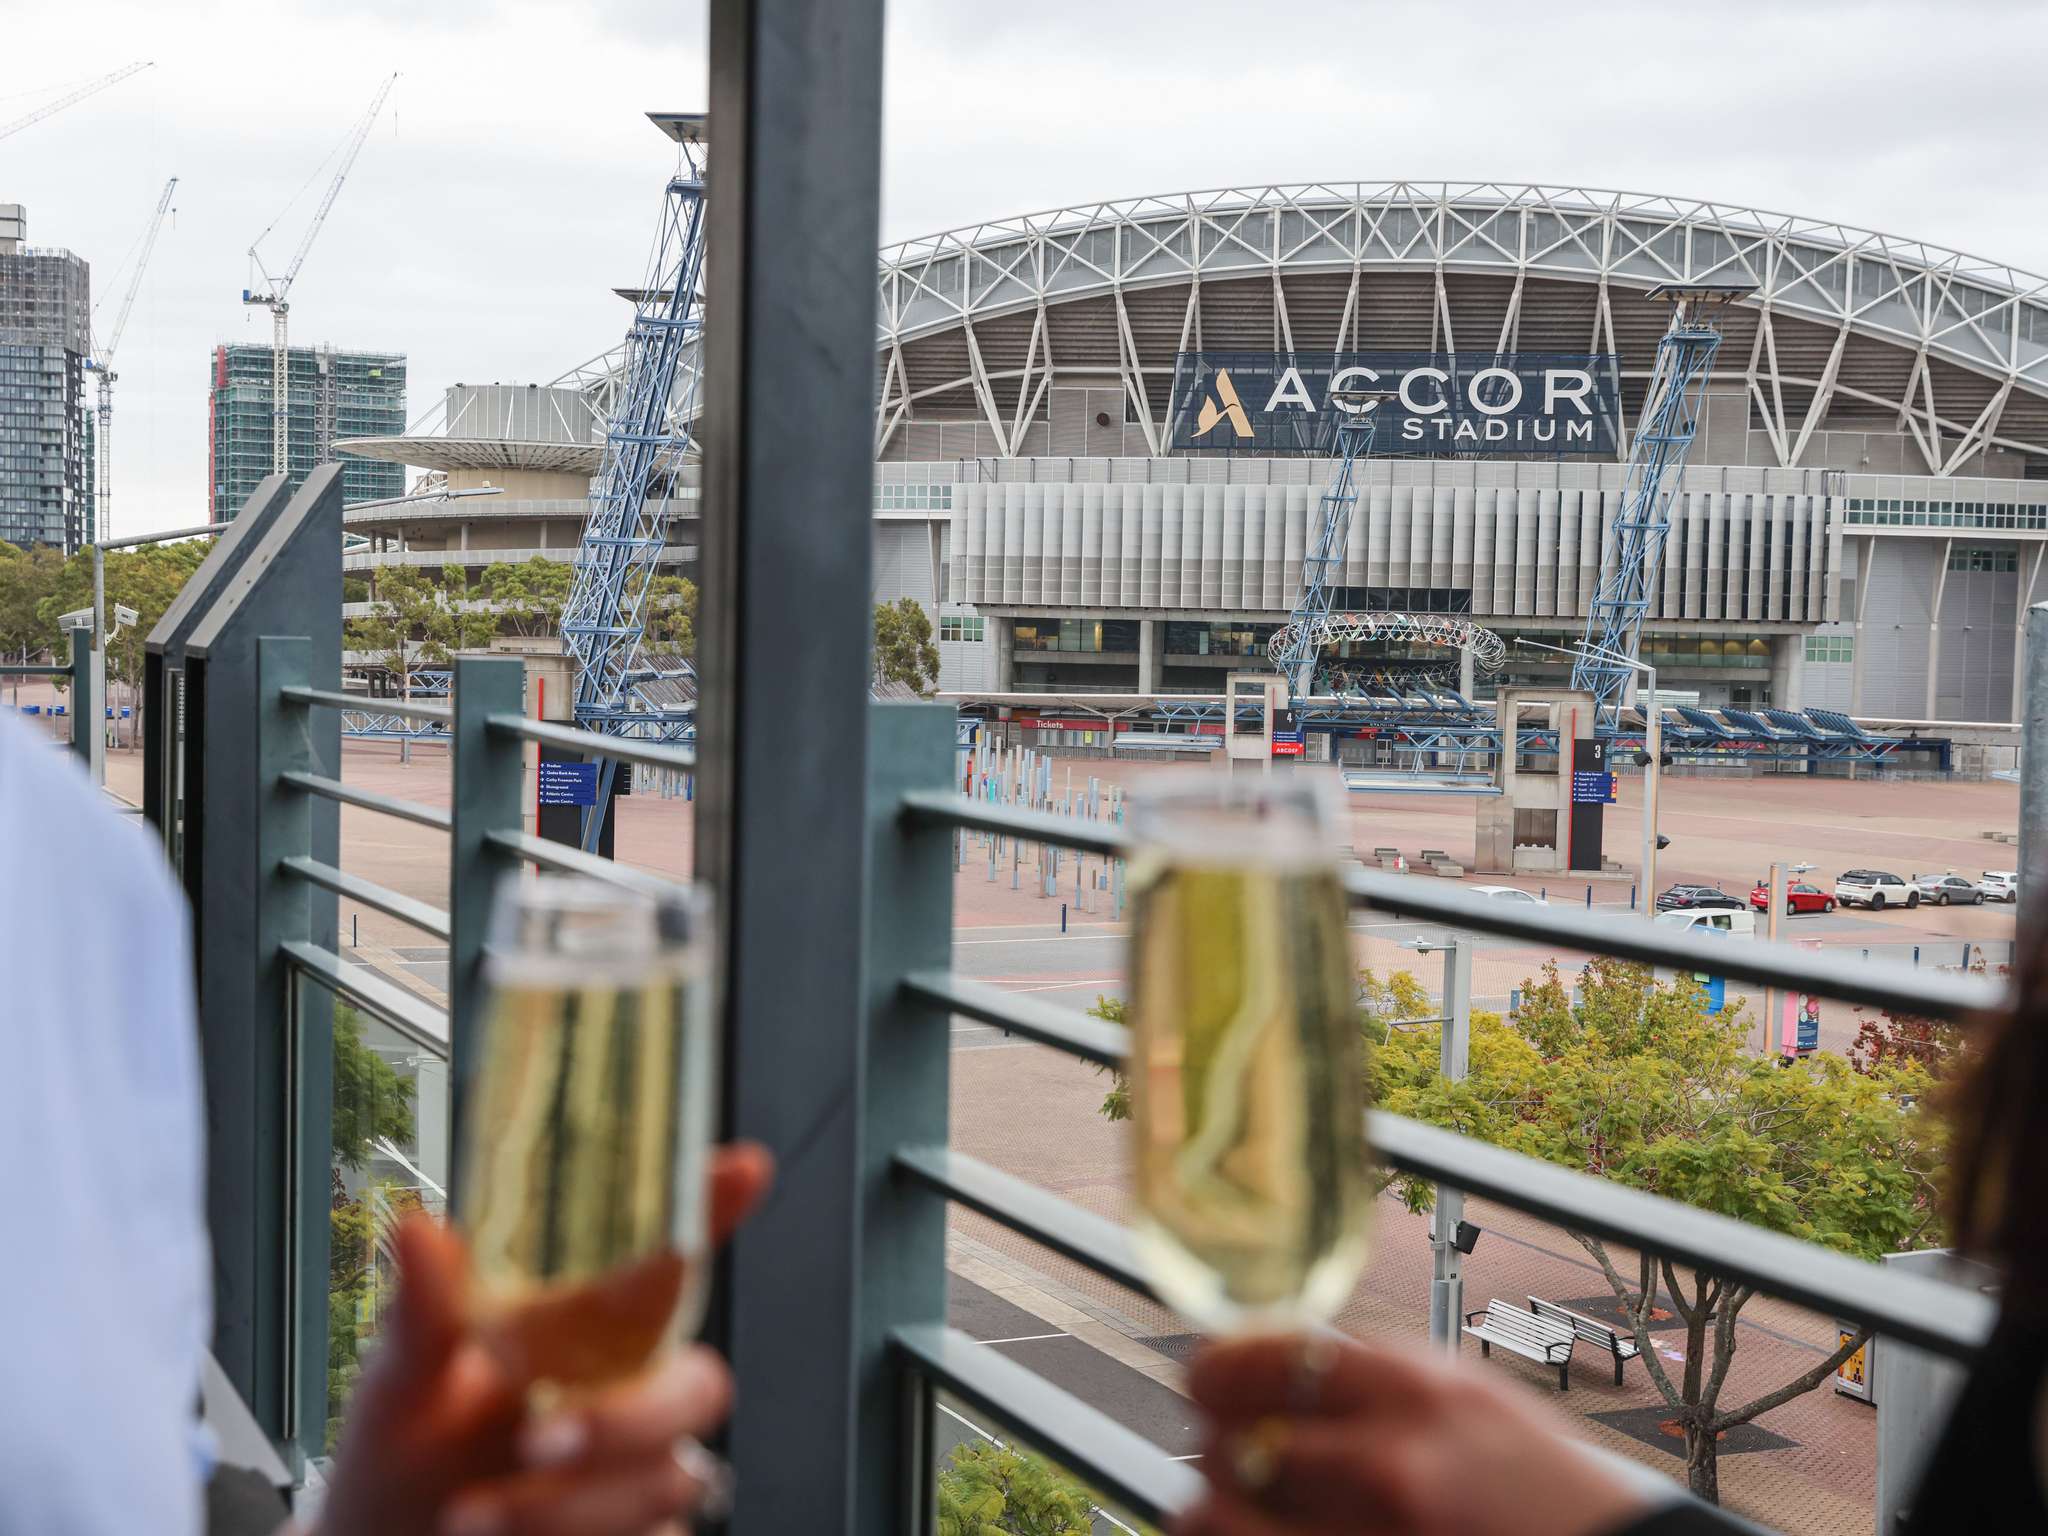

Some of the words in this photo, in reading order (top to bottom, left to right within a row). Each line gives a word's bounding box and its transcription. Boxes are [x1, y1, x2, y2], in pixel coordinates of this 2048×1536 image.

[1264, 366, 1593, 416] ACCOR
[1402, 418, 1593, 442] STADIUM
[1036, 719, 1064, 729] Tickets
[1287, 712, 1292, 723] 4
[1594, 744, 1601, 759] 3
